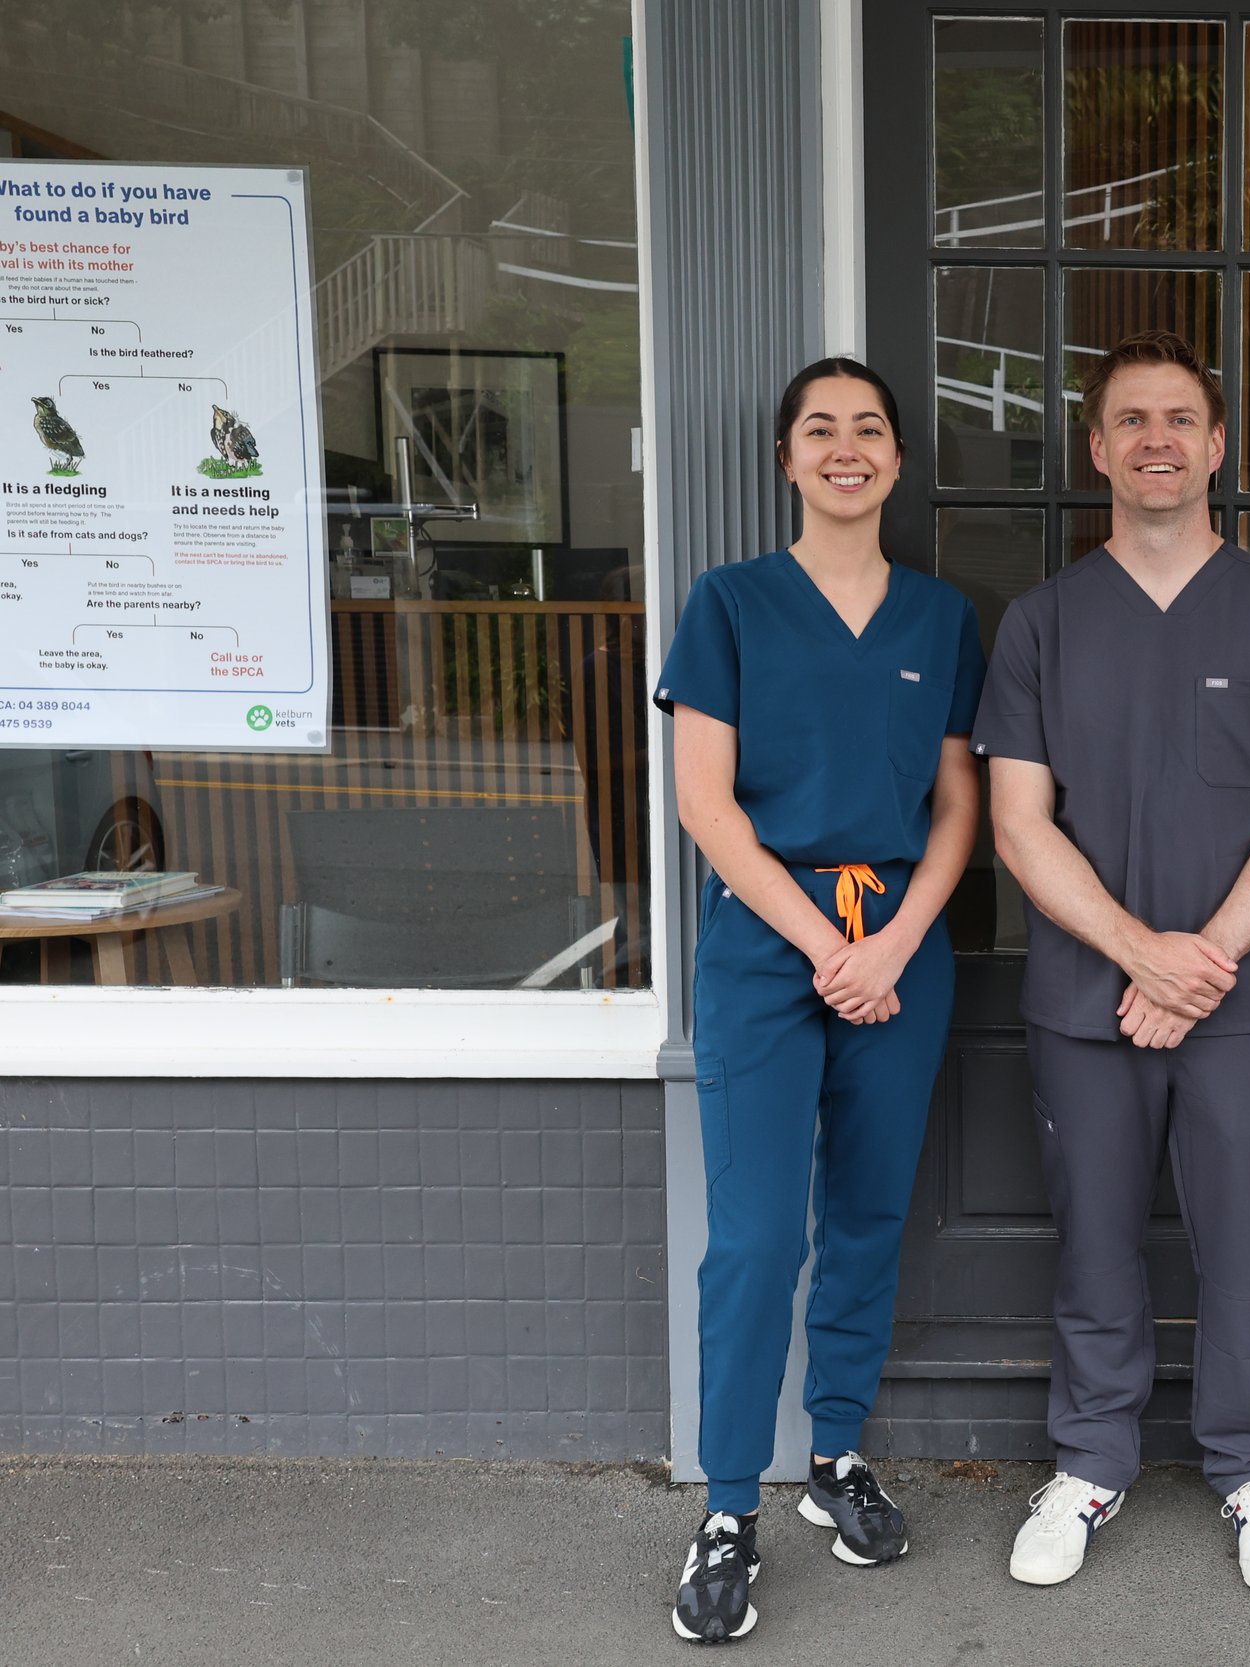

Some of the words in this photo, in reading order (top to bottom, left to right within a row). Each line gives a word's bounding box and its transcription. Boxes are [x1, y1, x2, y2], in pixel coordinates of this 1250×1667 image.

[45, 182, 66, 198] to
[71, 182, 96, 198] do
[102, 182, 115, 198] if
[120, 187, 158, 203] you
[163, 184, 211, 201] have
[14, 206, 72, 223] found
[78, 211, 90, 223] a
[95, 207, 144, 228] baby
[150, 208, 189, 226] bird
[30, 241, 59, 253] best
[62, 242, 110, 254] chance
[112, 243, 131, 255] for
[23, 258, 34, 270] is
[38, 259, 65, 270] with
[69, 259, 84, 271] its
[88, 260, 134, 272] mother
[9, 295, 25, 304] the
[27, 295, 46, 304] bird
[49, 296, 69, 305] hurt
[84, 297, 110, 306] sick?
[6, 324, 23, 334] Yes
[91, 326, 105, 335] No
[90, 348, 98, 357] Is
[101, 348, 116, 357] the
[119, 348, 138, 358] bird
[140, 349, 194, 359] feathered?
[93, 381, 110, 390] Yes
[178, 383, 192, 392] No
[3, 483, 13, 494] It
[17, 483, 29, 494] is
[33, 486, 41, 494] a
[45, 483, 107, 499] fledgling
[172, 485, 181, 497] It
[185, 485, 197, 497] is
[201, 488, 210, 497] a
[214, 487, 270, 501] nestling
[172, 504, 198, 515] and
[203, 505, 245, 516] needs
[249, 505, 279, 520] help
[8, 529, 16, 538] Is
[19, 530, 25, 538] it
[28, 530, 48, 539] safe
[51, 530, 73, 539] from
[75, 531, 96, 540] cats
[98, 531, 116, 540] and
[119, 531, 148, 542] dogs?
[21, 559, 39, 568] Yes
[106, 561, 120, 569] No
[1, 592, 23, 602] okay.
[87, 599, 104, 608] Are
[106, 600, 122, 608] the
[124, 601, 160, 610] parents
[163, 601, 201, 612] nearby?
[106, 630, 124, 639] Yes
[191, 632, 204, 640] No
[211, 652, 232, 662] Call
[55, 661, 75, 671] baby
[86, 662, 108, 671] okay.
[211, 667, 229, 676] the
[232, 667, 264, 677] SPCA
[19, 701, 33, 710] 04
[37, 701, 59, 711] 389
[61, 702, 90, 711] 8044
[275, 709, 313, 720] kelburn
[23, 720, 52, 729] 9539
[275, 719, 296, 728] vets
